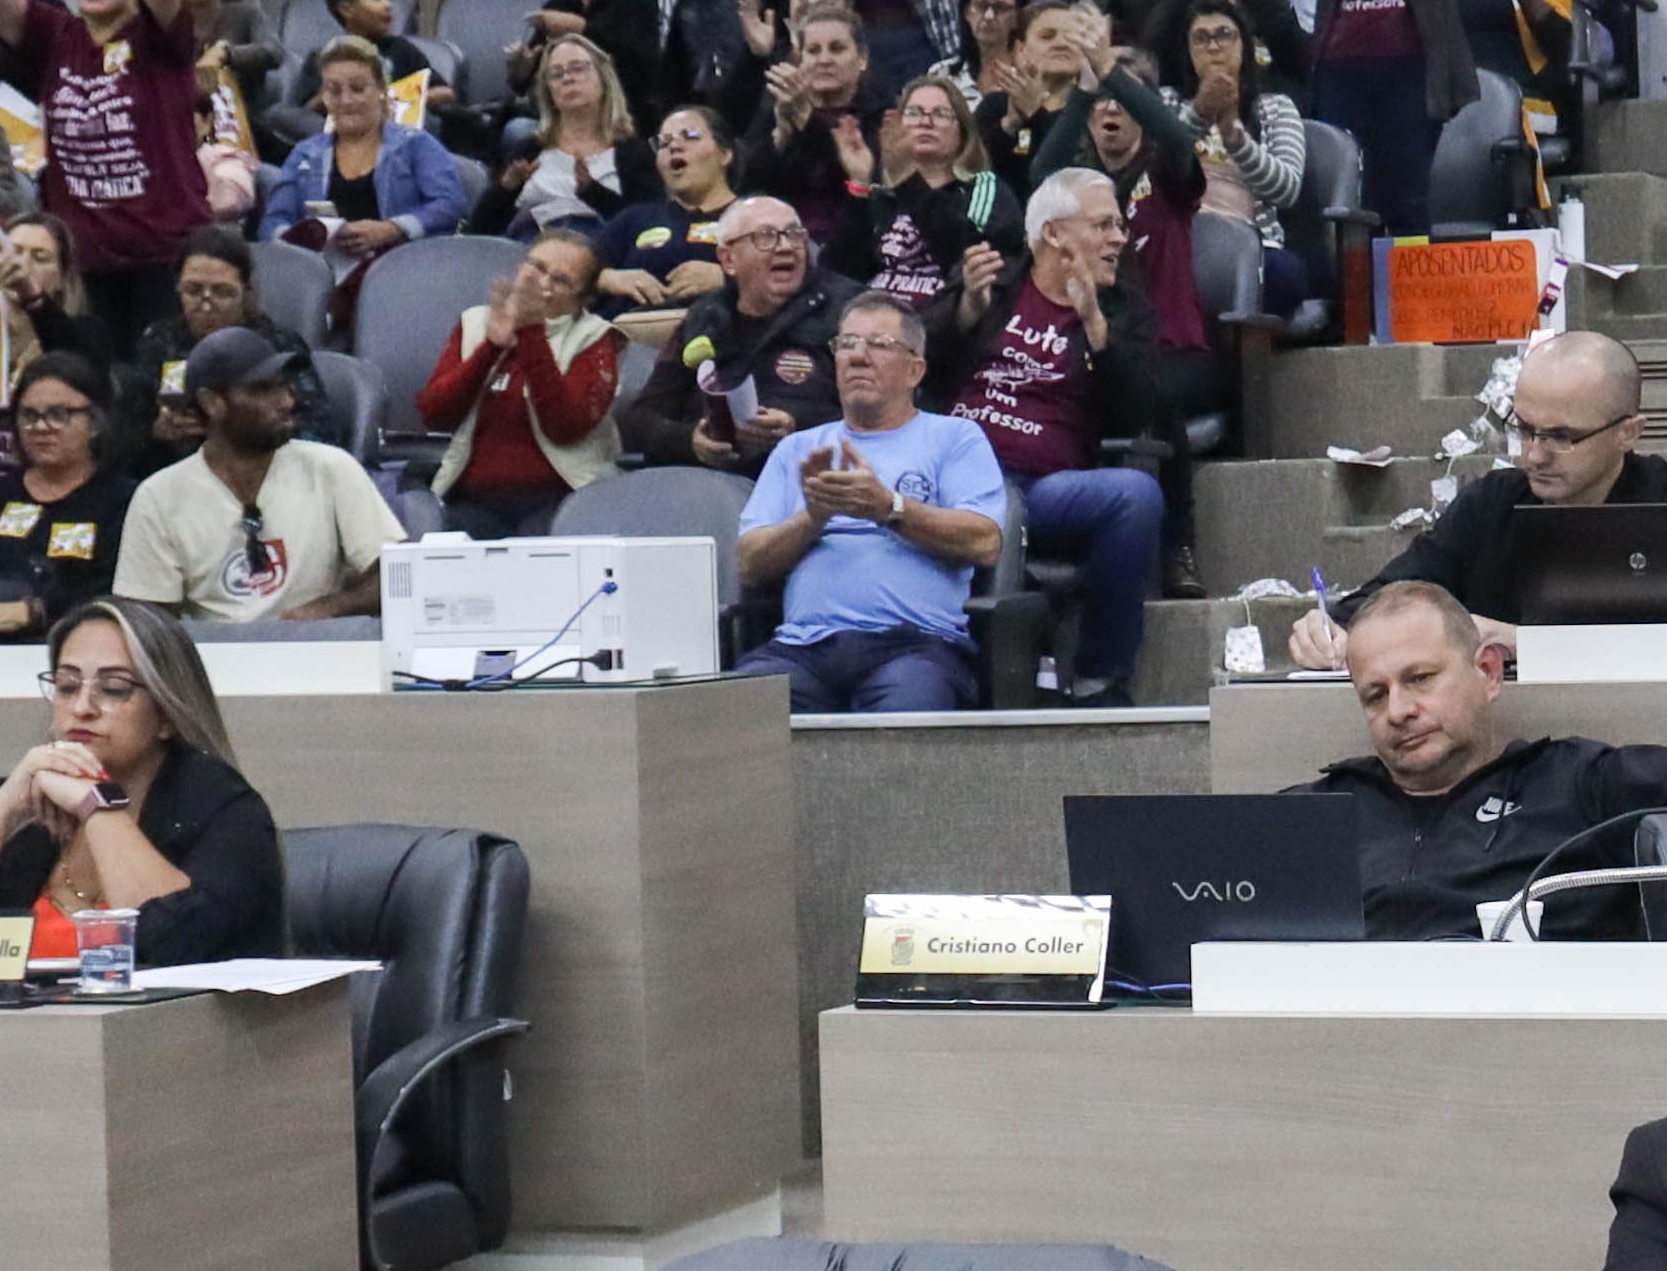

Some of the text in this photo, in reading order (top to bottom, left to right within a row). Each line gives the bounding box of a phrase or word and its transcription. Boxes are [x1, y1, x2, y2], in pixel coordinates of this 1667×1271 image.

[1396, 244, 1526, 278] APOSENTADOS
[1004, 314, 1069, 356] Lute
[984, 387, 1018, 408] um
[950, 402, 1044, 436] Professor
[1172, 879, 1256, 902] VAIO
[926, 935, 1085, 955] Cristiano Coller
